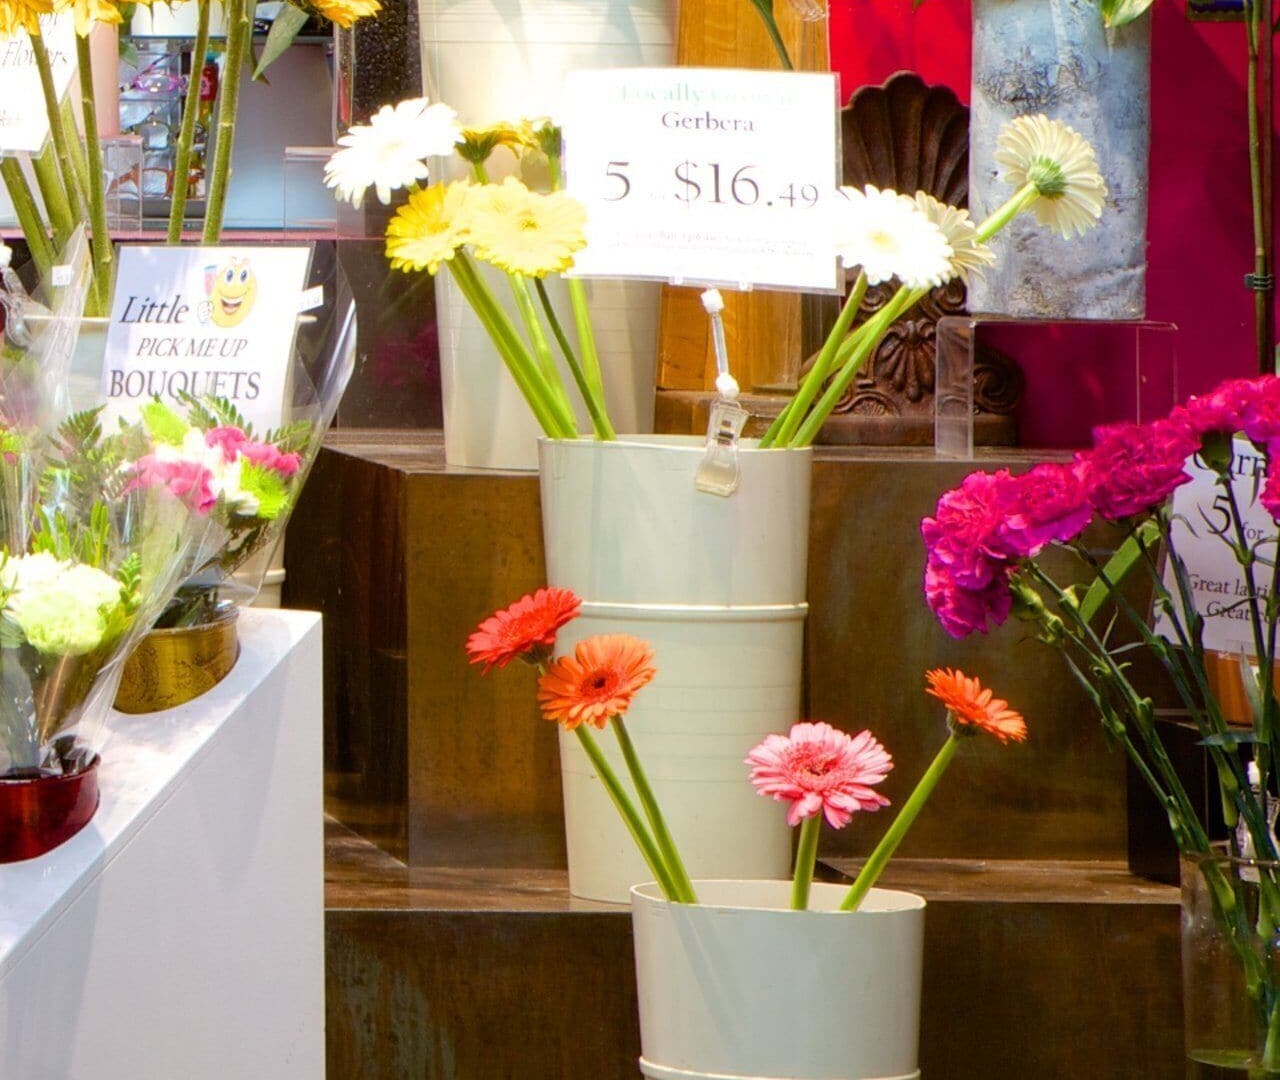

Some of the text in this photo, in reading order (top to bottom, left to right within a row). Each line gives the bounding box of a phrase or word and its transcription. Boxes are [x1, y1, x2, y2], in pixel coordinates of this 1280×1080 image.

[661, 110, 755, 133] Gerbera
[602, 160, 631, 202] 5
[673, 158, 820, 209] $16.49
[118, 294, 190, 325] Little
[136, 337, 248, 358] PICK ME UP
[108, 369, 261, 406] BOUQUETS
[1207, 494, 1264, 541] 5 for
[1189, 573, 1231, 594] Great
[1206, 601, 1251, 621] Great
